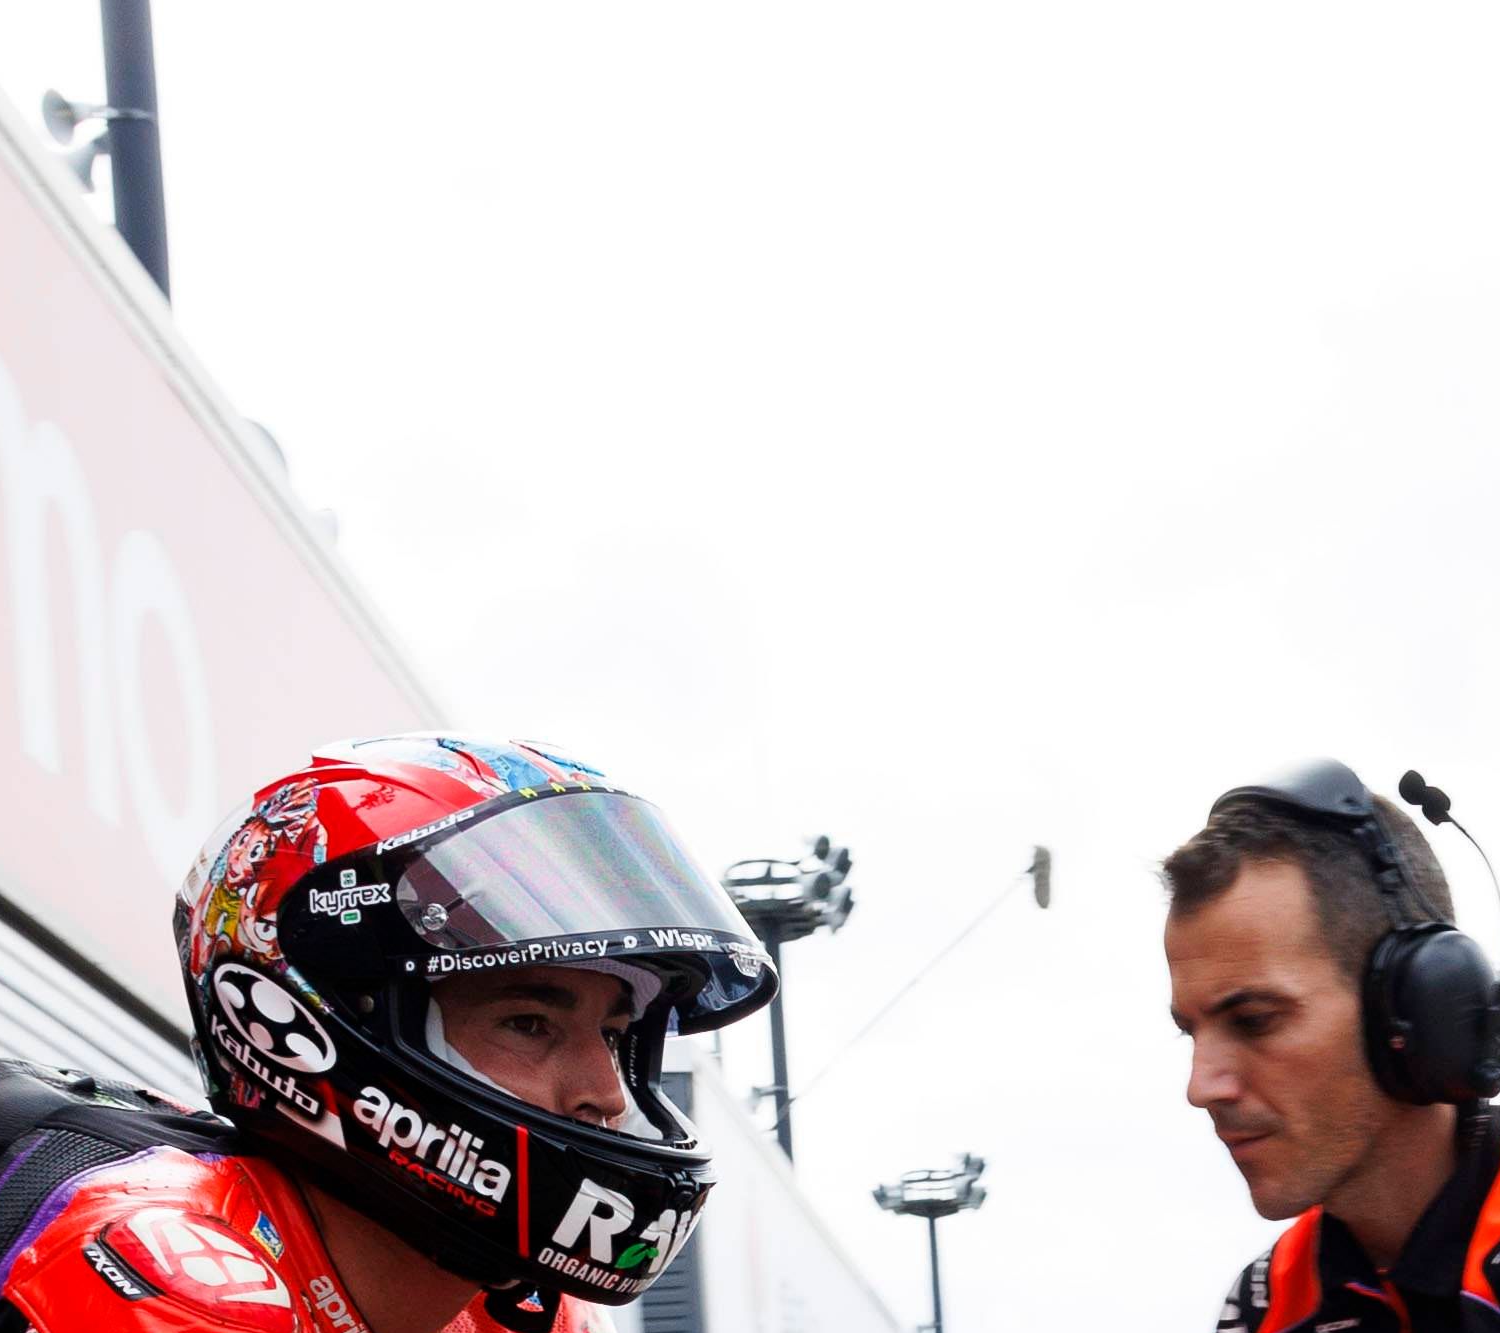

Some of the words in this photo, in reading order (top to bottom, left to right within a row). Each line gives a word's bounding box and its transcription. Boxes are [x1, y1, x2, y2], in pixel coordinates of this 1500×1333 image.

[377, 809, 476, 855] Kabuto
[309, 883, 392, 916] kyrrex
[426, 936, 609, 975] #DiscoverPrivacy
[211, 1014, 322, 1116] Kabuto
[353, 1085, 511, 1204] aprilia
[388, 1150, 498, 1217] RACING
[85, 1242, 143, 1297] IXON
[537, 1246, 621, 1291] ORGANIC
